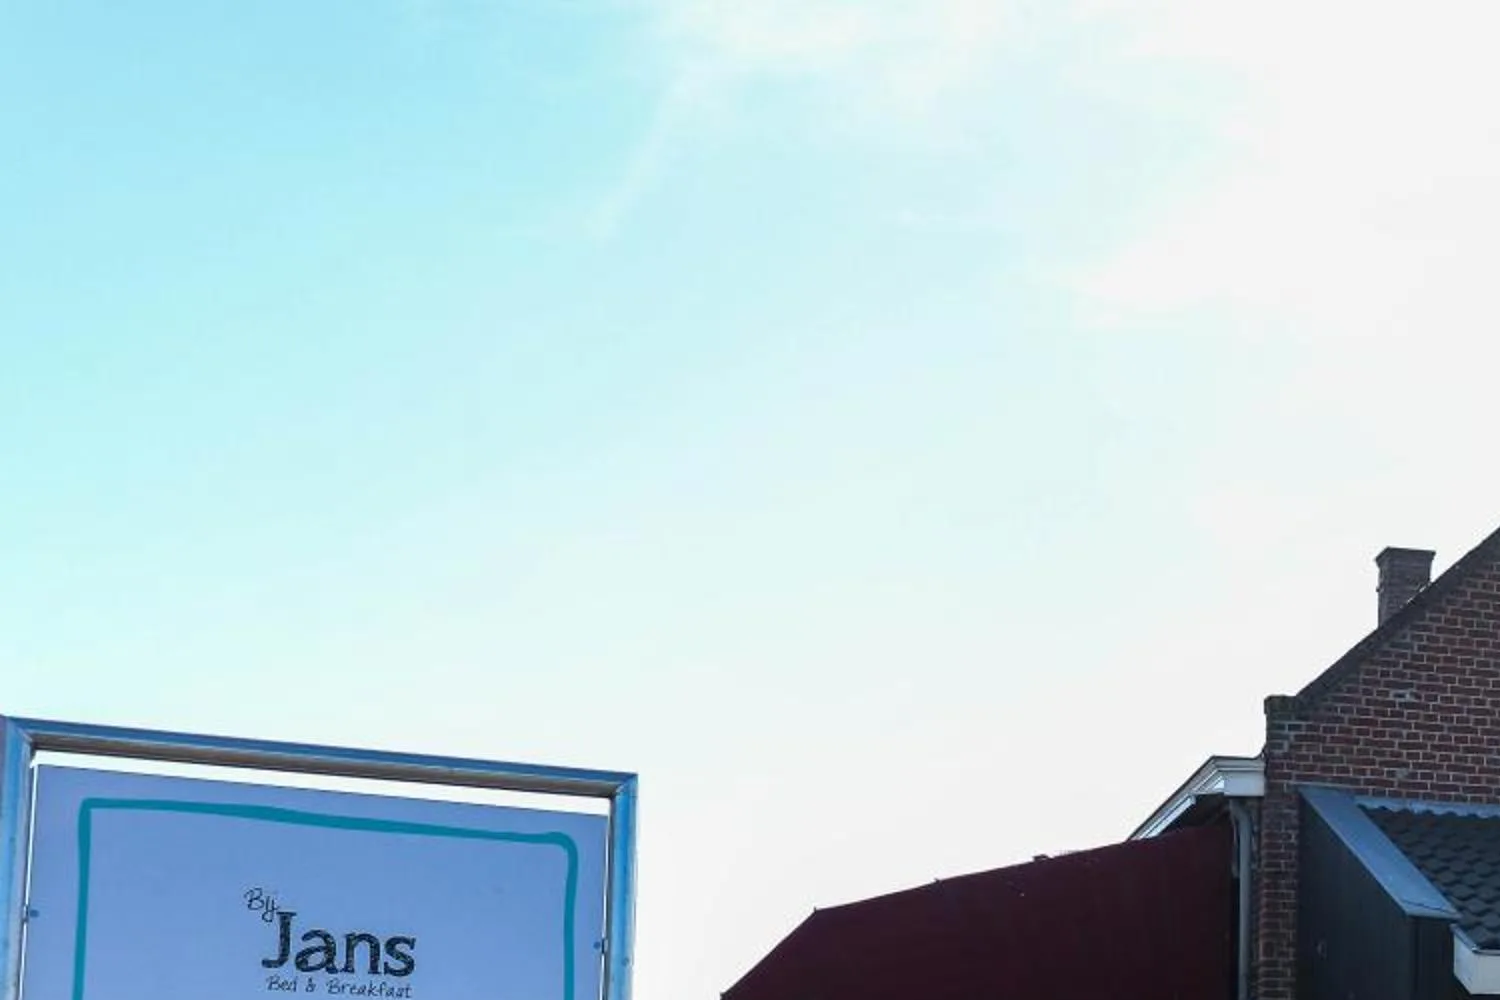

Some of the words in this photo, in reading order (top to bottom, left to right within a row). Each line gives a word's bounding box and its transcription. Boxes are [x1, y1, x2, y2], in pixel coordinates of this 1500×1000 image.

[261, 911, 416, 976] Jans
[266, 974, 298, 993] Bed
[305, 976, 316, 993] &
[326, 977, 414, 999] Breakfast
